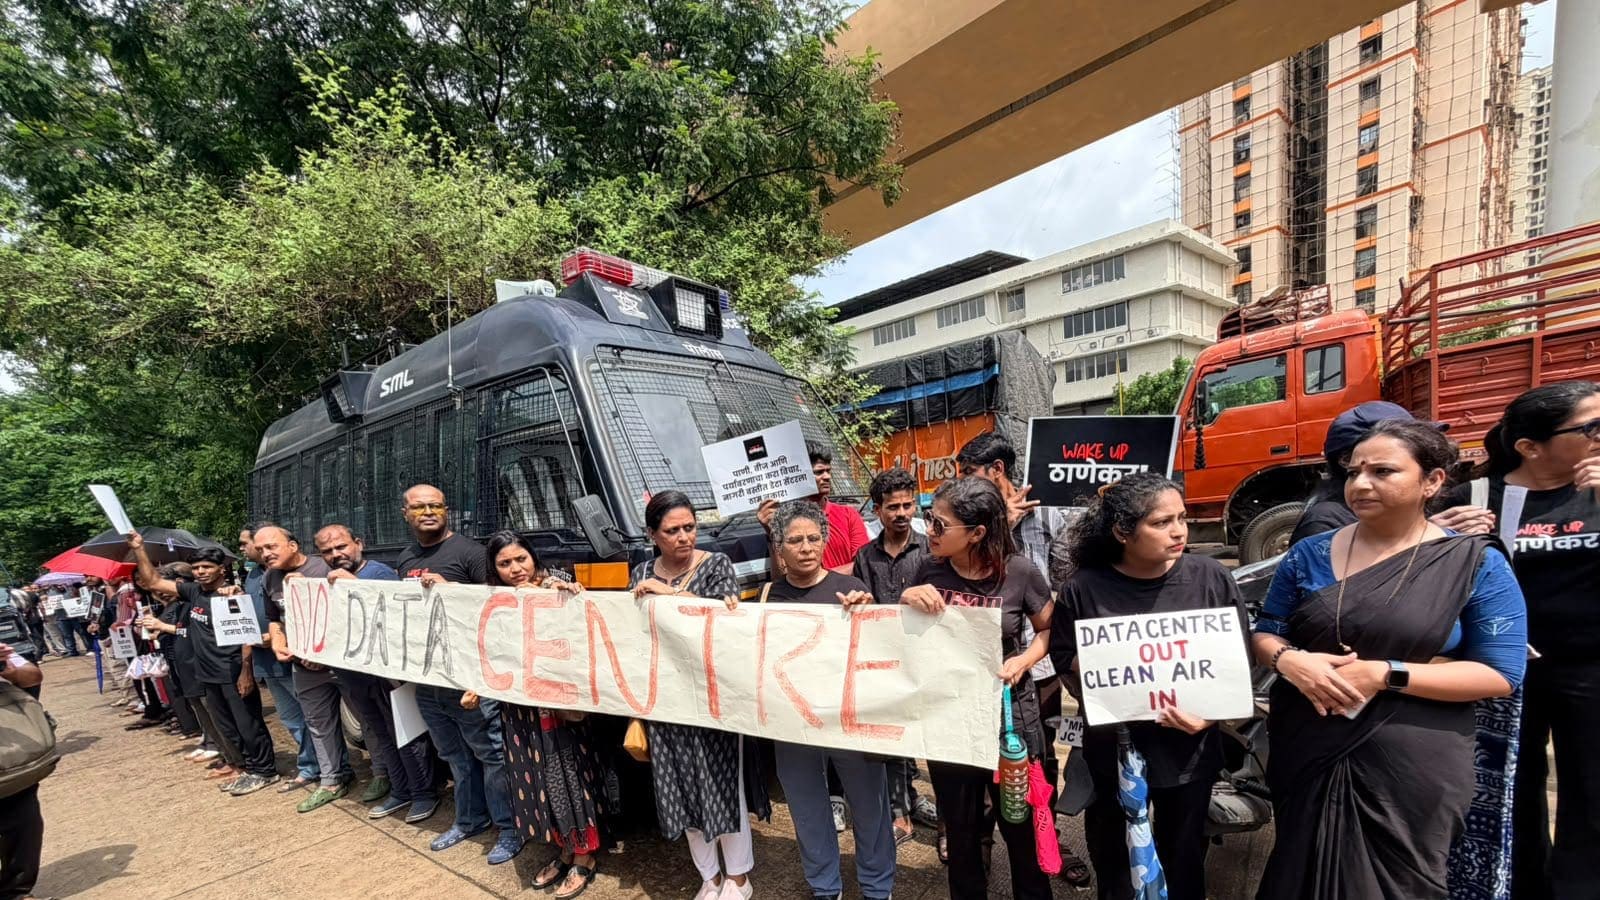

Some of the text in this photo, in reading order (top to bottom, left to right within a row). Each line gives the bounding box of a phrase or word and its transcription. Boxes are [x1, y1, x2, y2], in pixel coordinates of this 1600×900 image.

[380, 369, 414, 398] SML
[1062, 442, 1130, 461] WAKE UP
[1563, 521, 1584, 533] UP
[290, 582, 905, 740] NO DATA CENTRE
[1139, 639, 1189, 664] OUT
[1084, 659, 1215, 690] CLEAN AIR
[1148, 688, 1179, 711] IN
